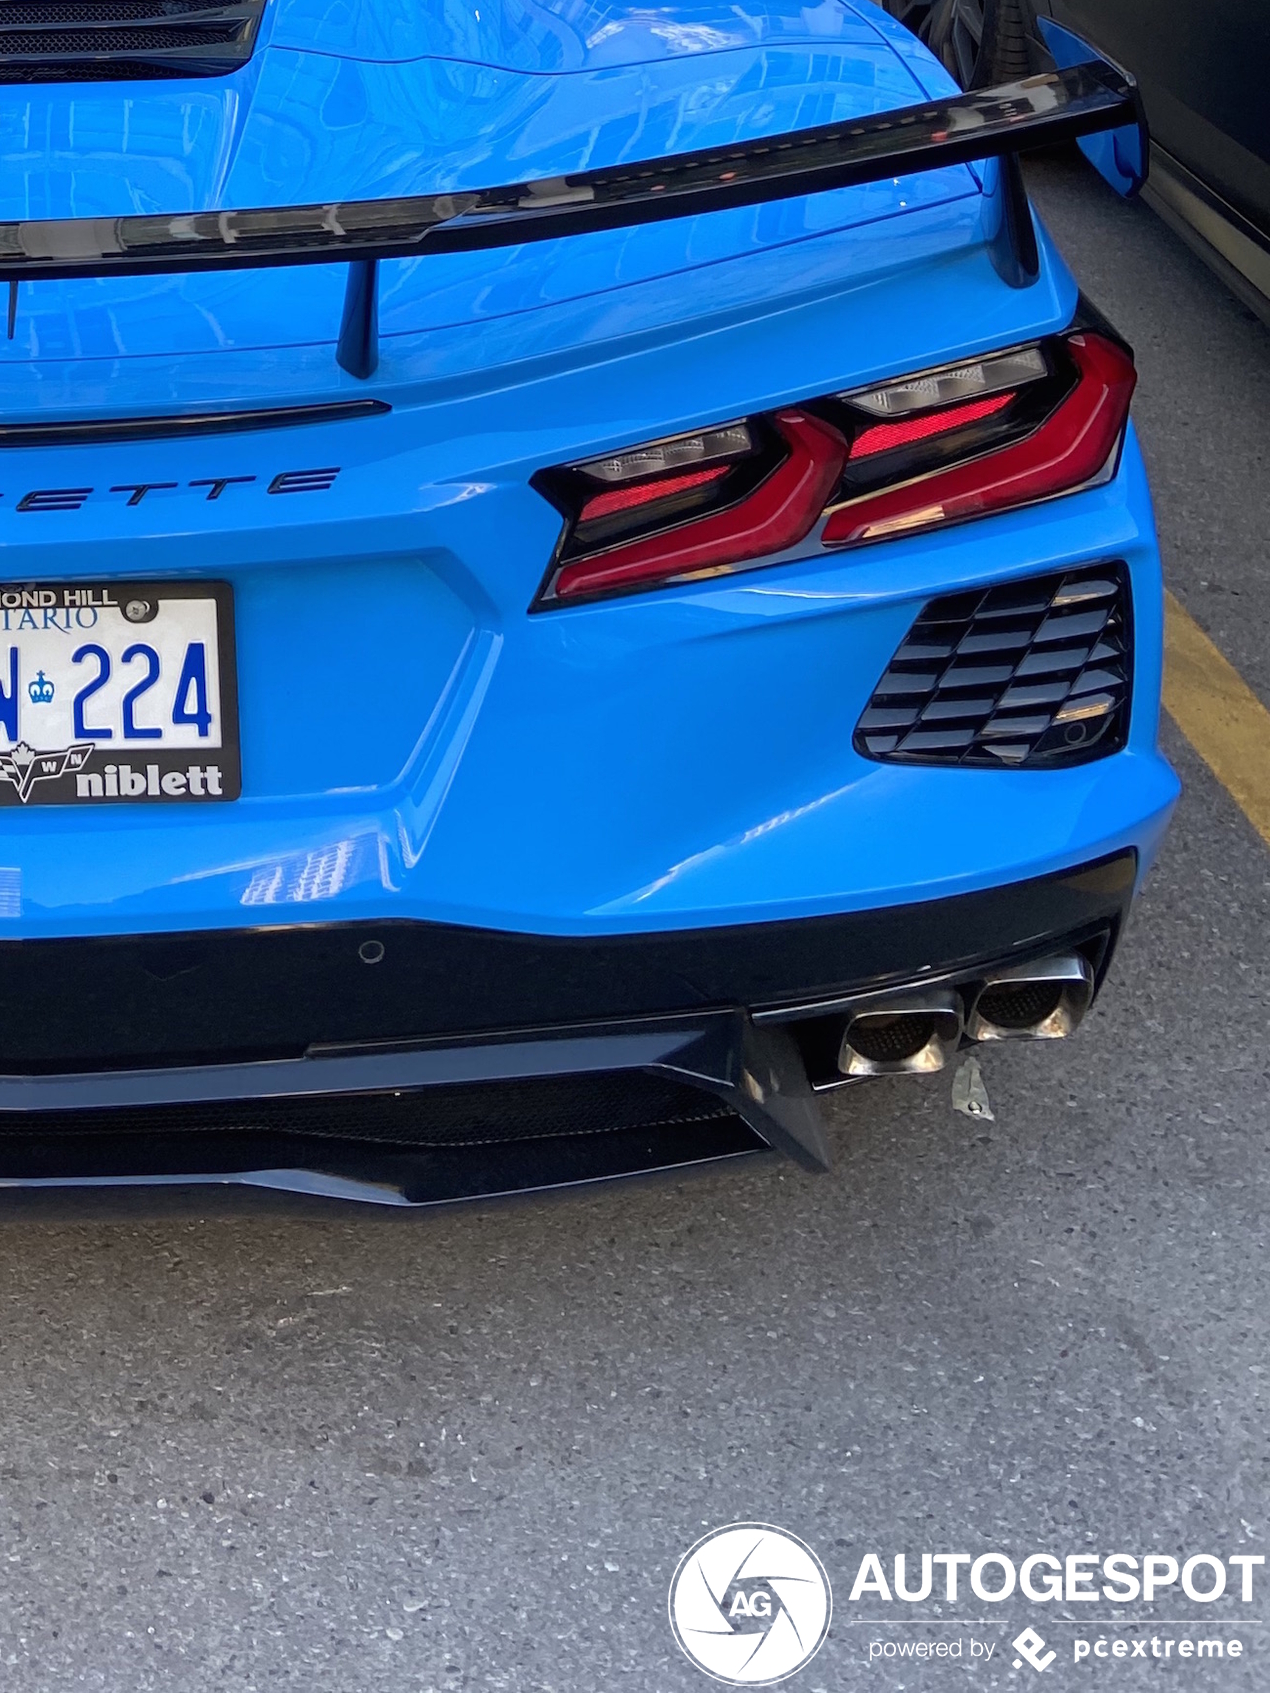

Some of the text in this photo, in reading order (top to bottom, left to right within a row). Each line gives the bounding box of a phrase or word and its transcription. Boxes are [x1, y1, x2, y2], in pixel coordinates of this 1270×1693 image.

[63, 589, 118, 607] HILL
[71, 641, 212, 741] 224
[76, 763, 223, 798] niblett
